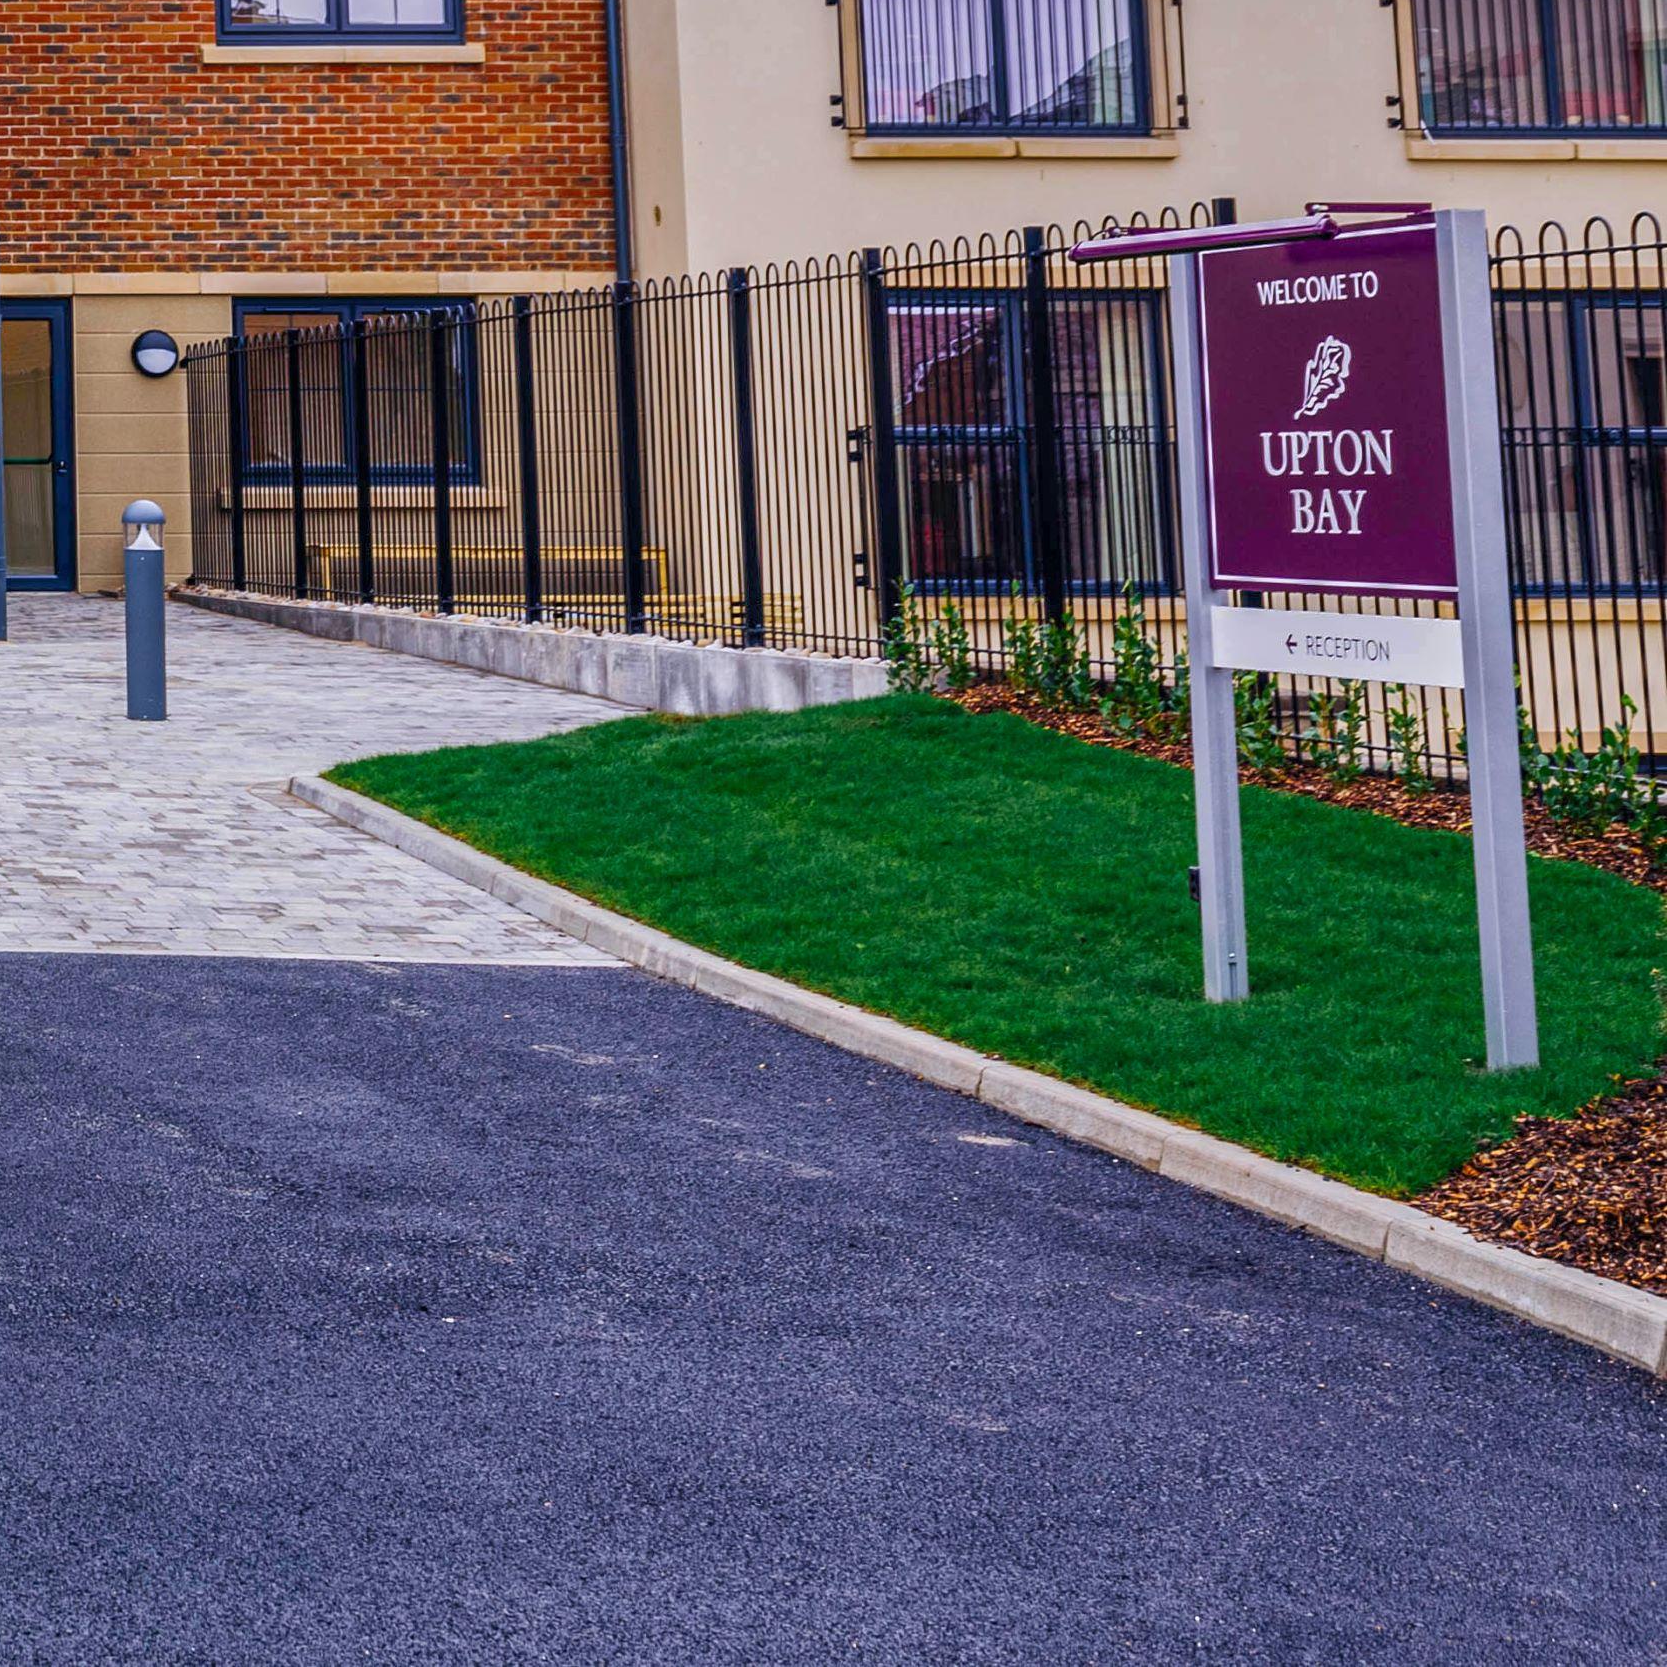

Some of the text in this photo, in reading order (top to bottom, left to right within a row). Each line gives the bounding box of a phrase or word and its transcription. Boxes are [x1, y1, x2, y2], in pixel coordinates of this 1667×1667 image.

[1256, 270, 1379, 306] WELCOME TO
[1259, 429, 1394, 477] UPTON
[1289, 488, 1368, 535] BAY
[1305, 635, 1391, 662] RECEPTION
